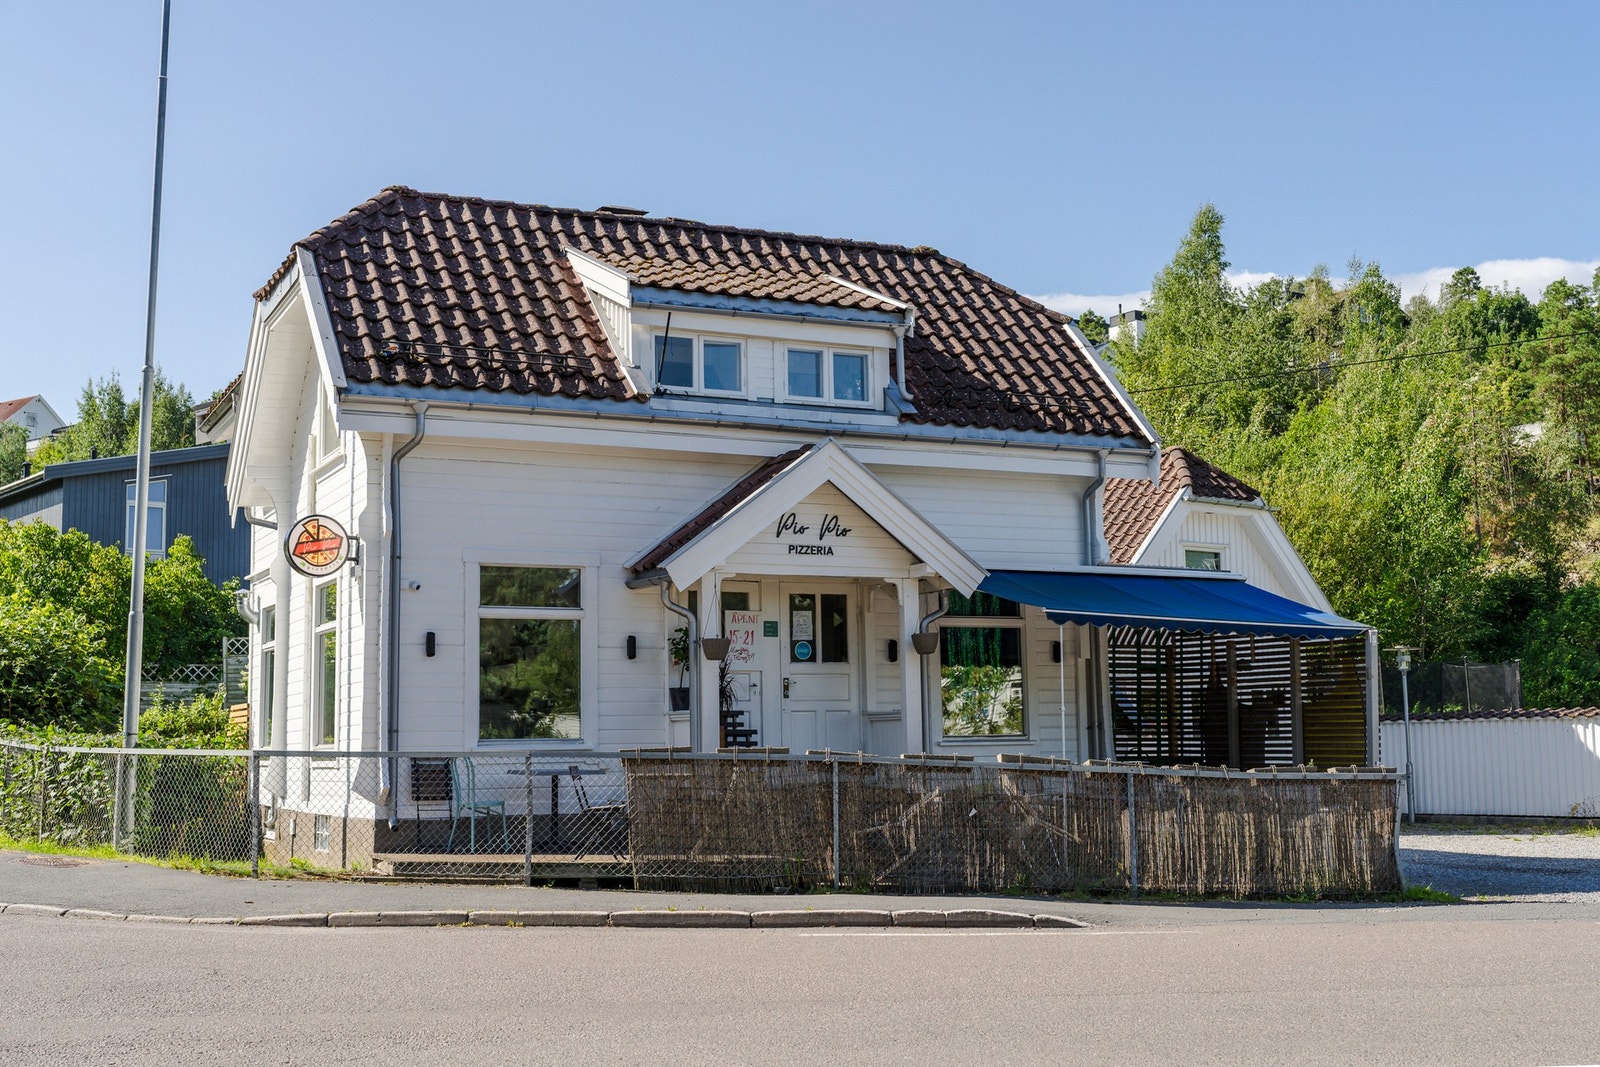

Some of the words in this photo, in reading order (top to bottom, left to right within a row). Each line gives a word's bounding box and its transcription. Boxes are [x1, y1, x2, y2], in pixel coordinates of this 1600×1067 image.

[776, 512, 810, 538] Pio
[819, 513, 852, 541] Pio
[788, 544, 834, 556] PIZZERIA
